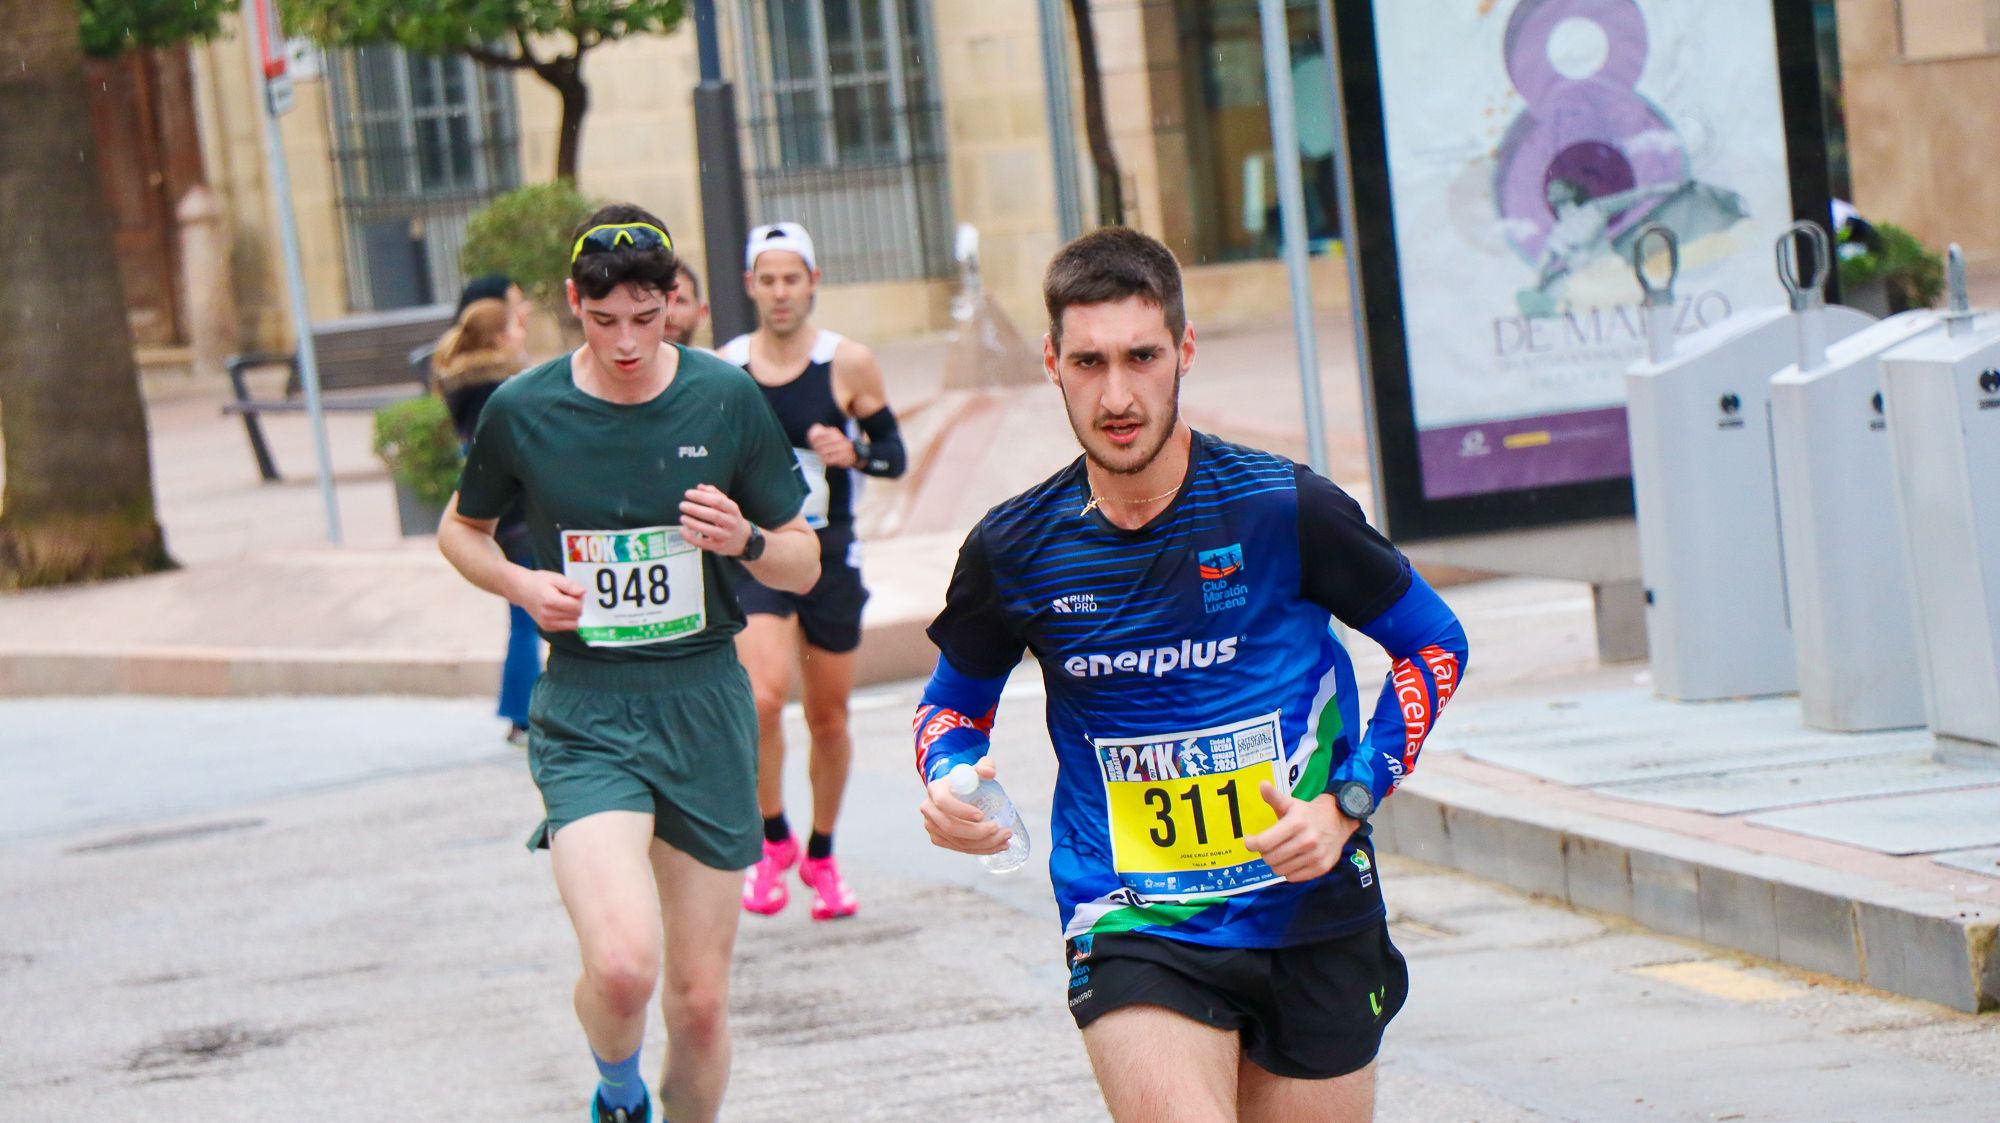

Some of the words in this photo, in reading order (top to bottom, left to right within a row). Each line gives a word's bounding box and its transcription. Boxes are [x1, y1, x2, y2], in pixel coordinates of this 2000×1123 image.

[1493, 315, 1551, 356] DE
[1563, 290, 1732, 346] MAZO
[678, 445, 708, 458] FILA
[573, 534, 618, 562] 10K
[596, 564, 671, 609] 948
[1202, 581, 1227, 593] Club
[1203, 584, 1248, 605] Maratón
[1070, 593, 1094, 603] RUN
[1074, 602, 1098, 613] PRO
[1204, 595, 1246, 614] Lucena
[1064, 636, 1238, 678] enerplus
[1120, 742, 1181, 782] 21K
[1214, 757, 1237, 772] 2026
[1144, 779, 1243, 848] 311
